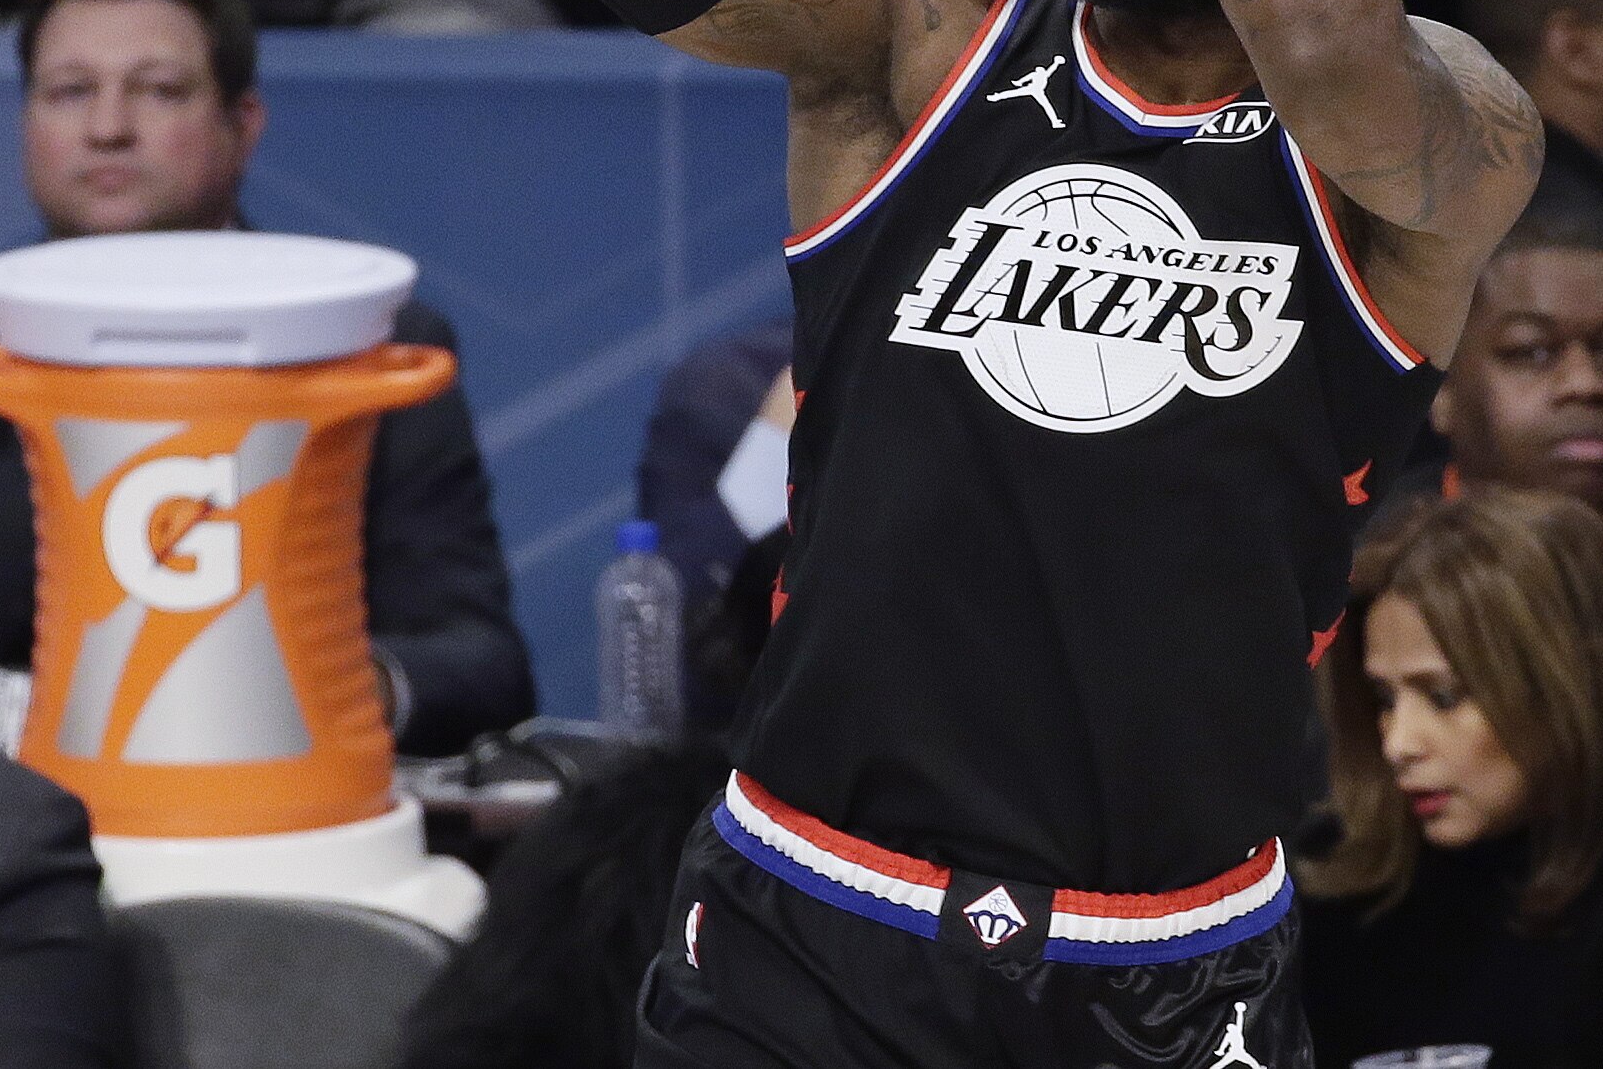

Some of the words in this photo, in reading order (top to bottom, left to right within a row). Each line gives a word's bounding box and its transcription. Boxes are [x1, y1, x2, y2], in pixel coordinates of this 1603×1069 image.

[1194, 109, 1262, 137] KIA
[908, 220, 1276, 381] LAKERS
[1032, 230, 1101, 255] LOS
[1105, 243, 1279, 275] ANGELES
[102, 452, 243, 613] G
